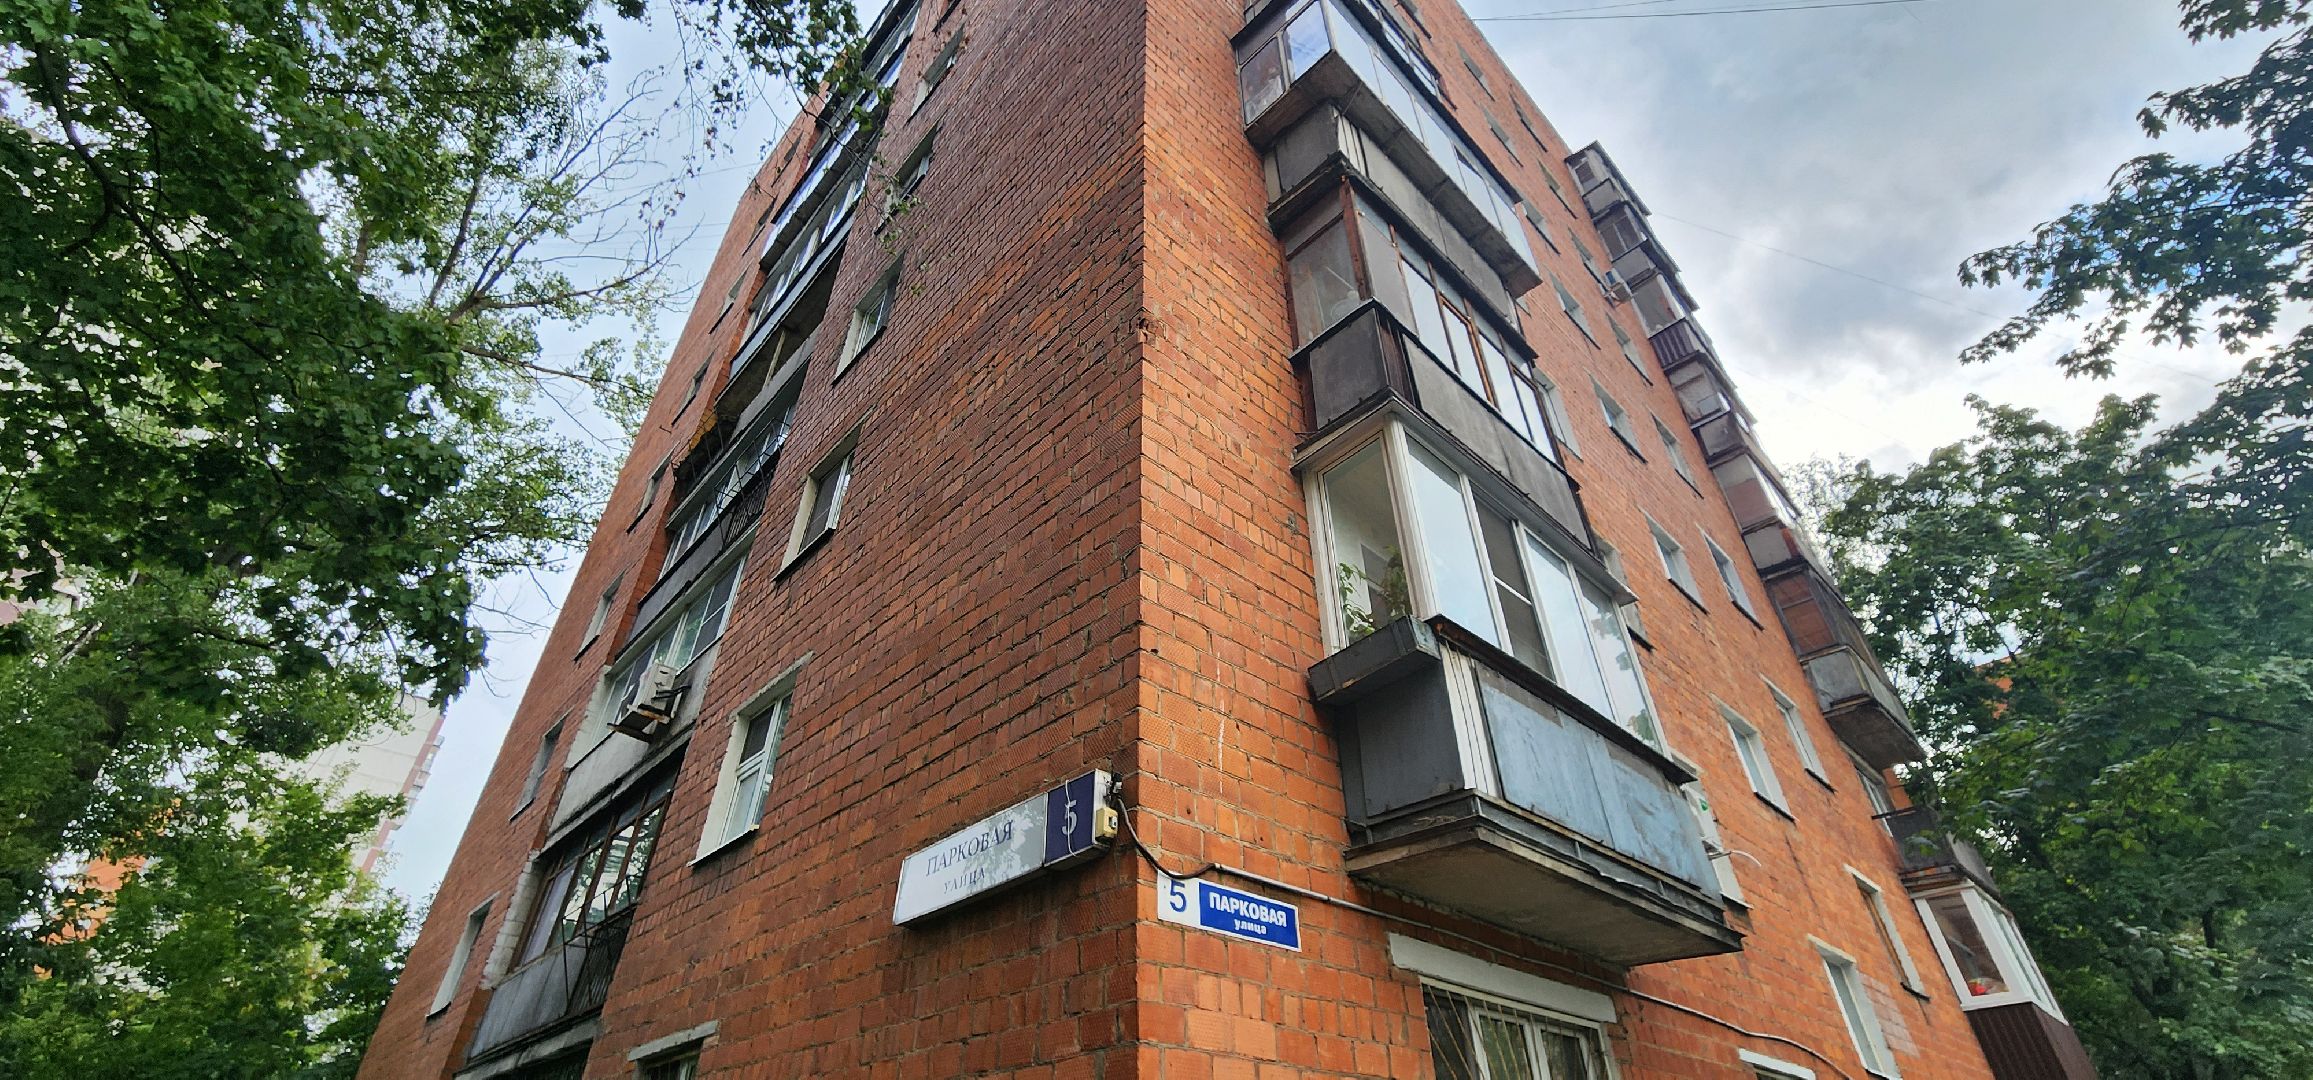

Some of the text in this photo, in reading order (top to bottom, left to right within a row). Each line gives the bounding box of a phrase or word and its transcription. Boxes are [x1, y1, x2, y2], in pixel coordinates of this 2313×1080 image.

[1061, 799, 1078, 836] 5
[925, 819, 1015, 877] ПАРКОВАЯ
[1169, 879, 1187, 913] 5
[1208, 891, 1288, 928] ПАРКОВАЯ
[1233, 918, 1267, 935] улица
